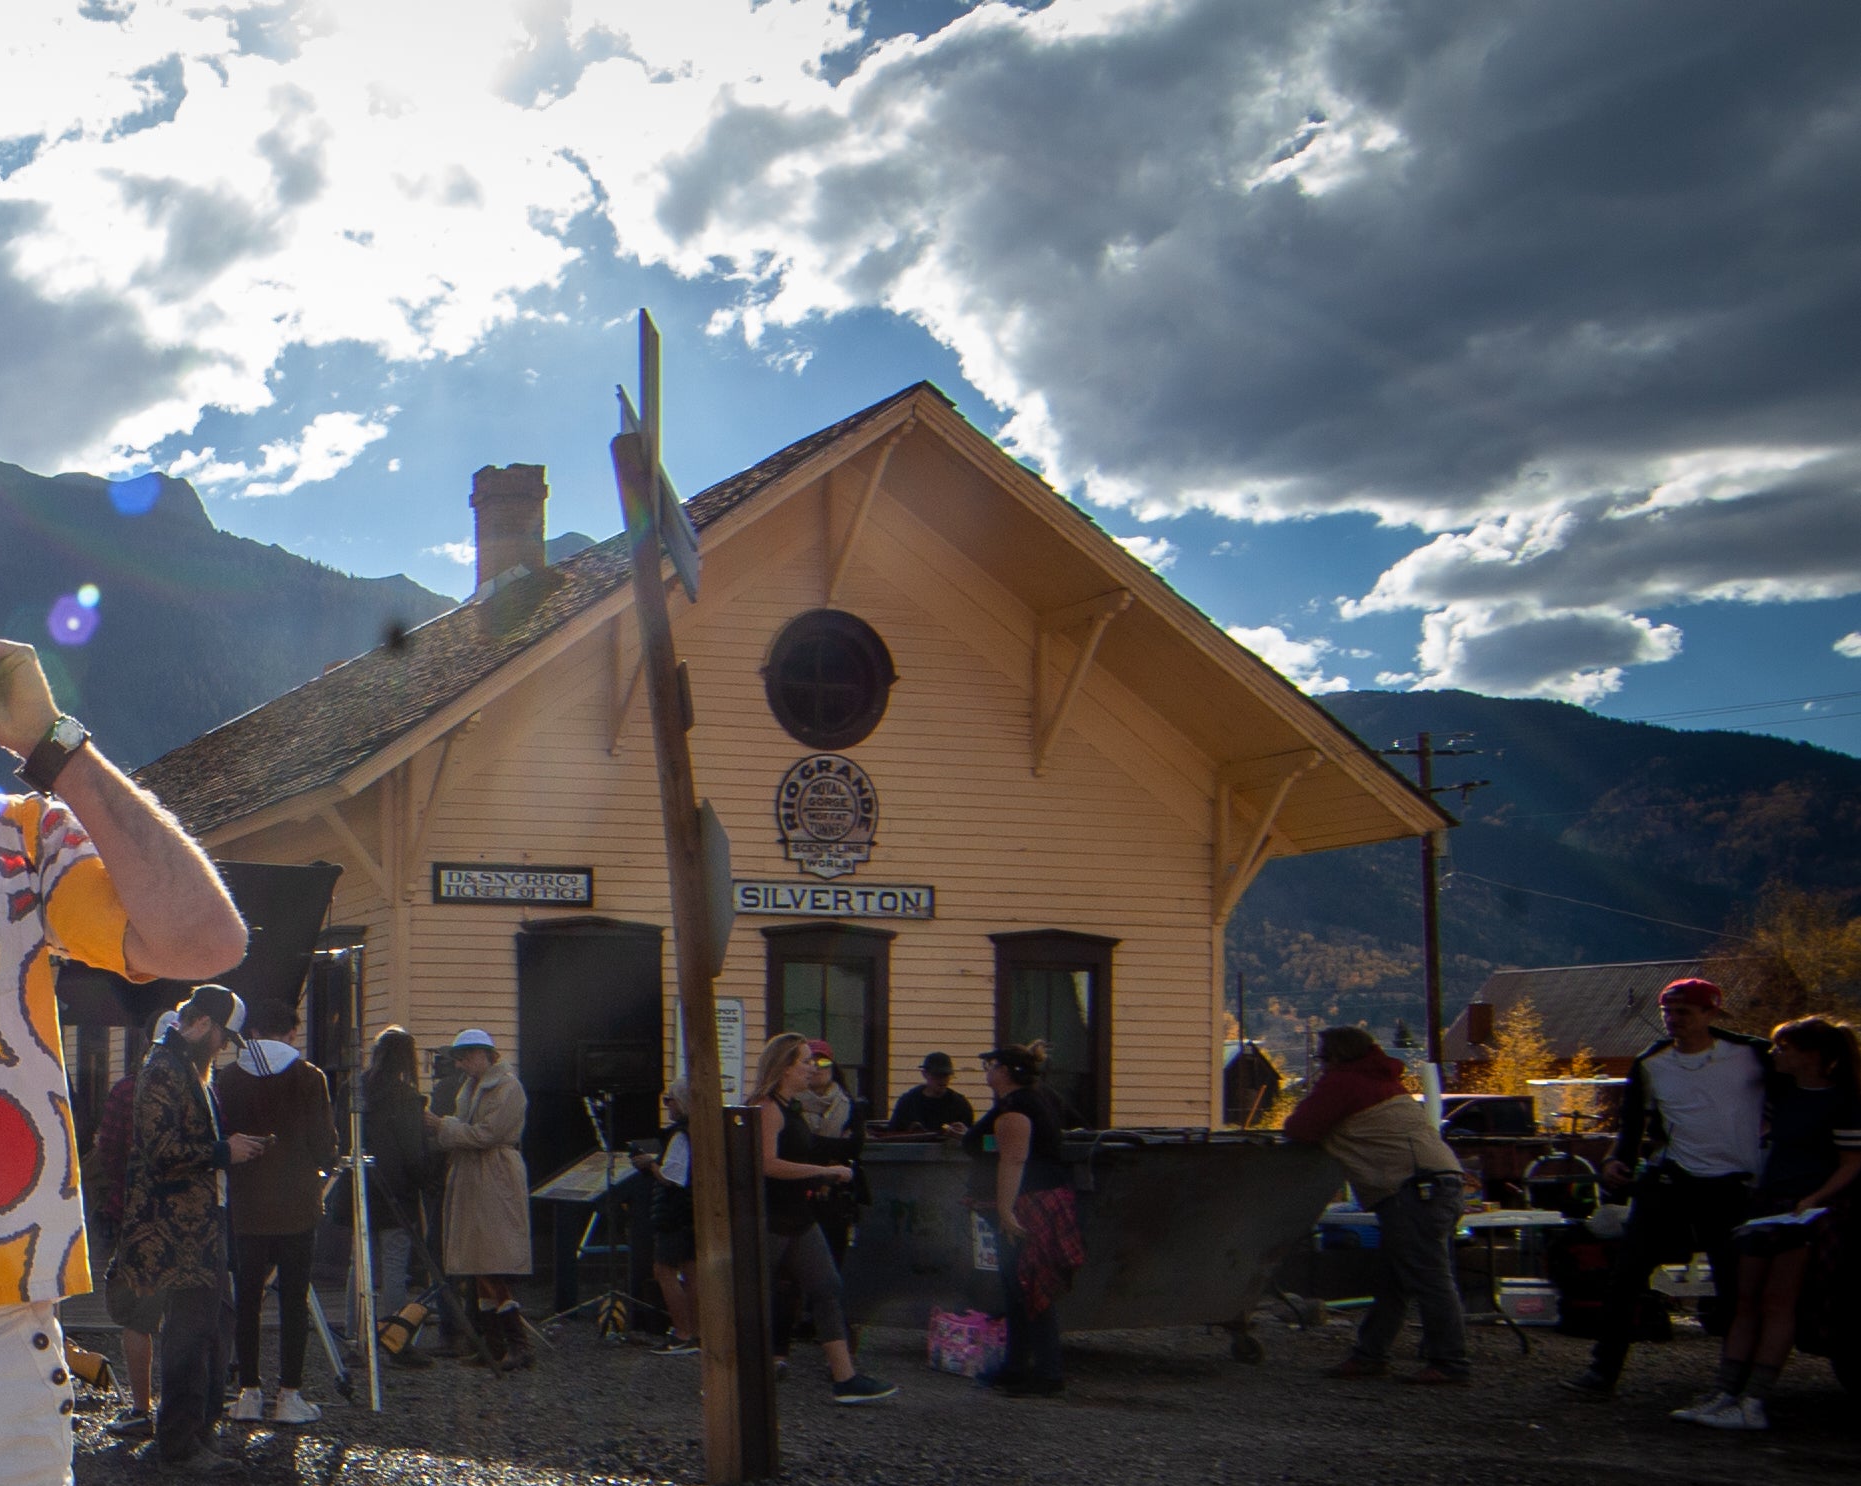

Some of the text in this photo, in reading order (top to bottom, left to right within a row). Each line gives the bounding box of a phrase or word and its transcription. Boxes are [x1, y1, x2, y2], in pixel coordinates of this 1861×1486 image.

[810, 781, 845, 795] ROYAL
[783, 759, 873, 832] RIO GRANDE
[808, 797, 848, 807] GORGE
[807, 813, 848, 821] MOFFAT
[809, 822, 848, 836] TUNNEL
[792, 843, 864, 853] SCENIC LINE
[806, 859, 851, 868] WORLD
[444, 883, 586, 900] TICKET OFFICE
[740, 886, 921, 913] SILVERTON
